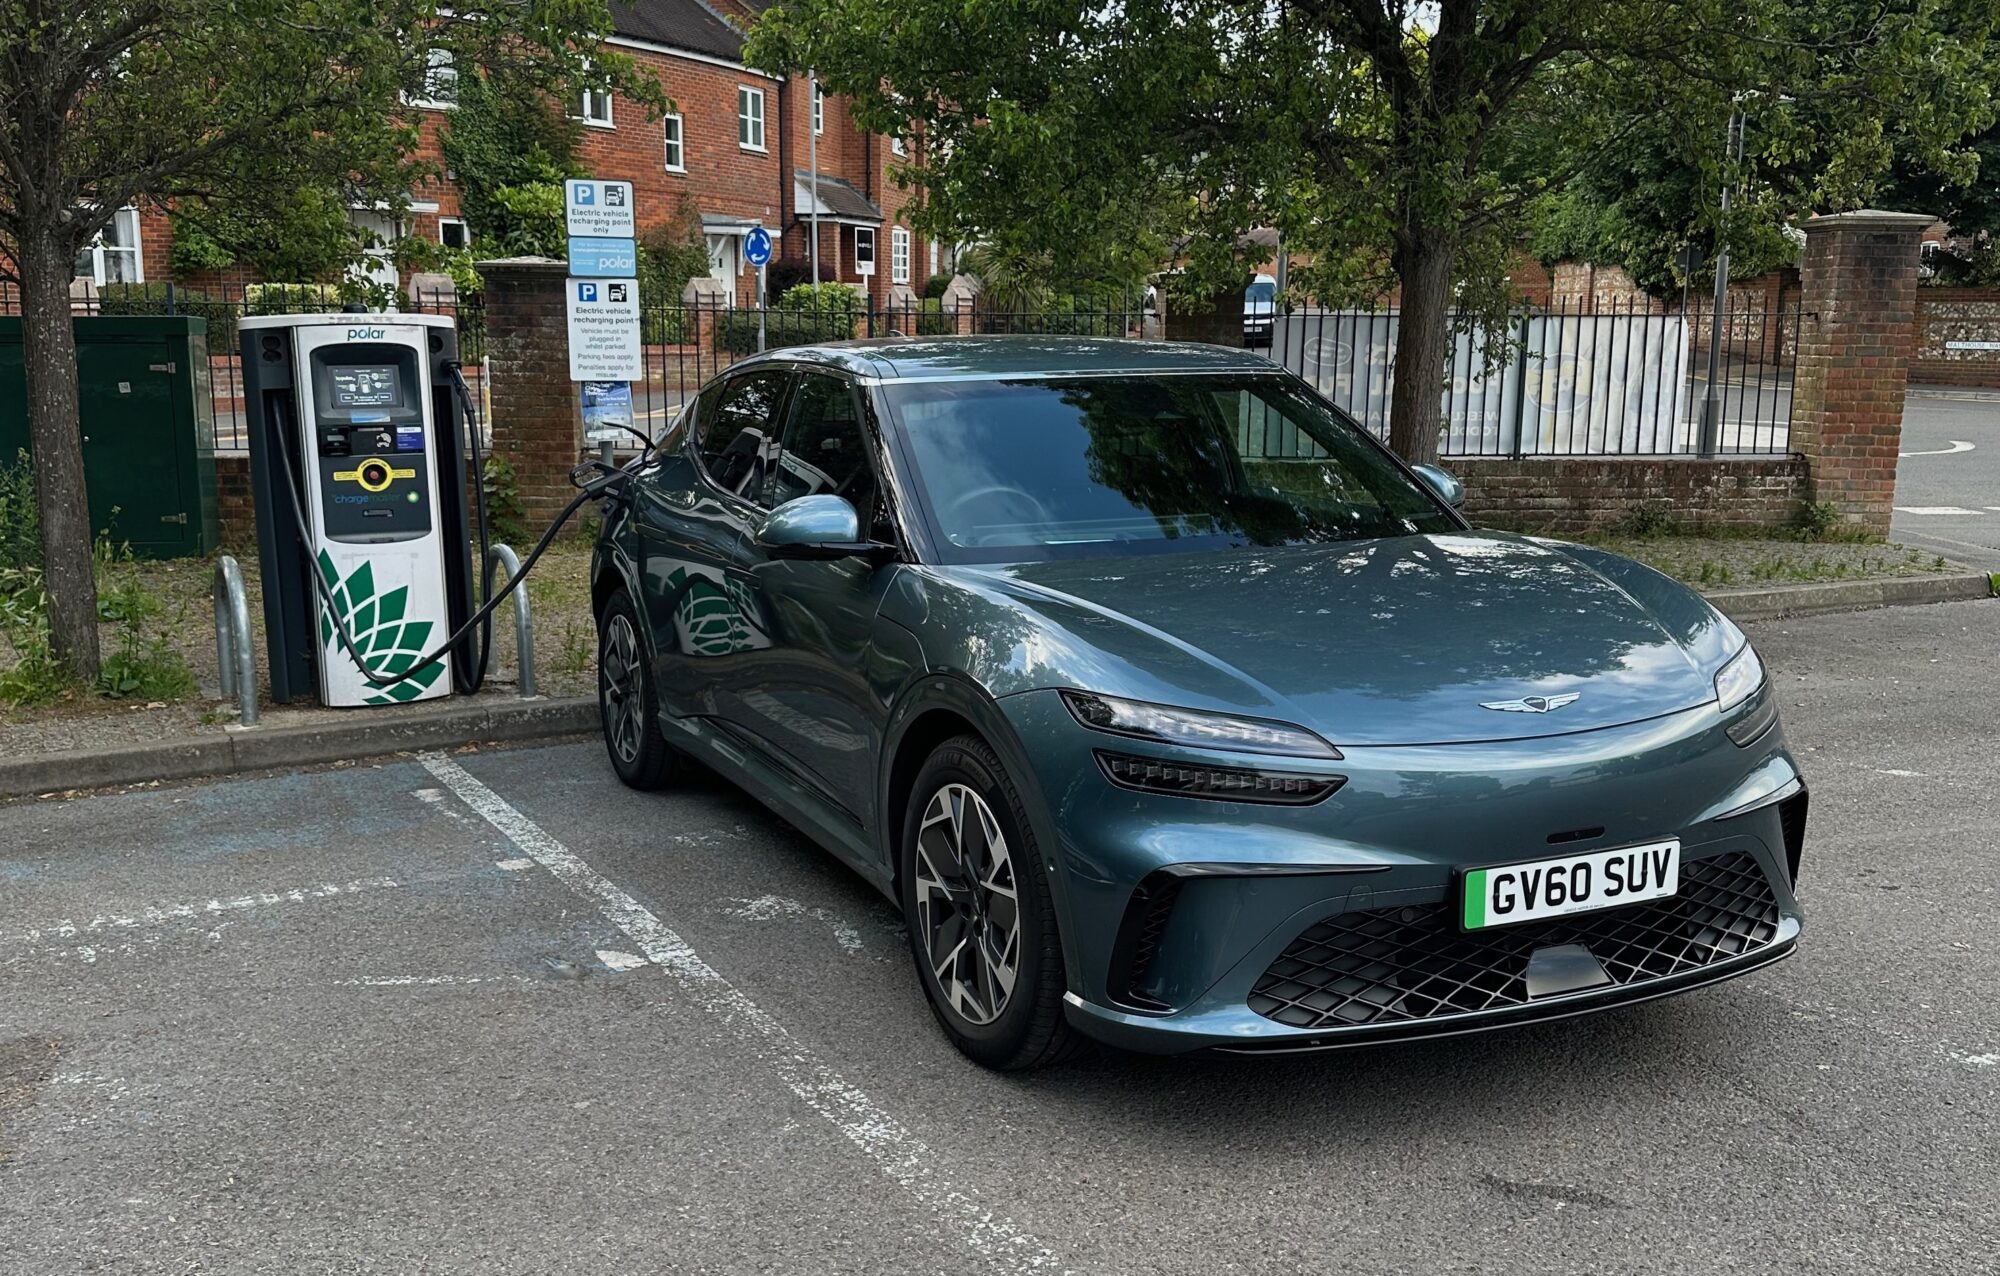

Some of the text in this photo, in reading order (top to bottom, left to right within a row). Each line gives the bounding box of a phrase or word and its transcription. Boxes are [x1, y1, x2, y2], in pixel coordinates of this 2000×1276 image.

[577, 185, 591, 203] P
[571, 208, 600, 216] Electric
[570, 218, 610, 226] recharging
[593, 226, 609, 234] only
[598, 256, 634, 271] polar
[582, 285, 595, 300] P
[574, 317, 634, 325] recharging point
[347, 326, 385, 341] polar
[1493, 848, 1672, 915] GV60 SUV
